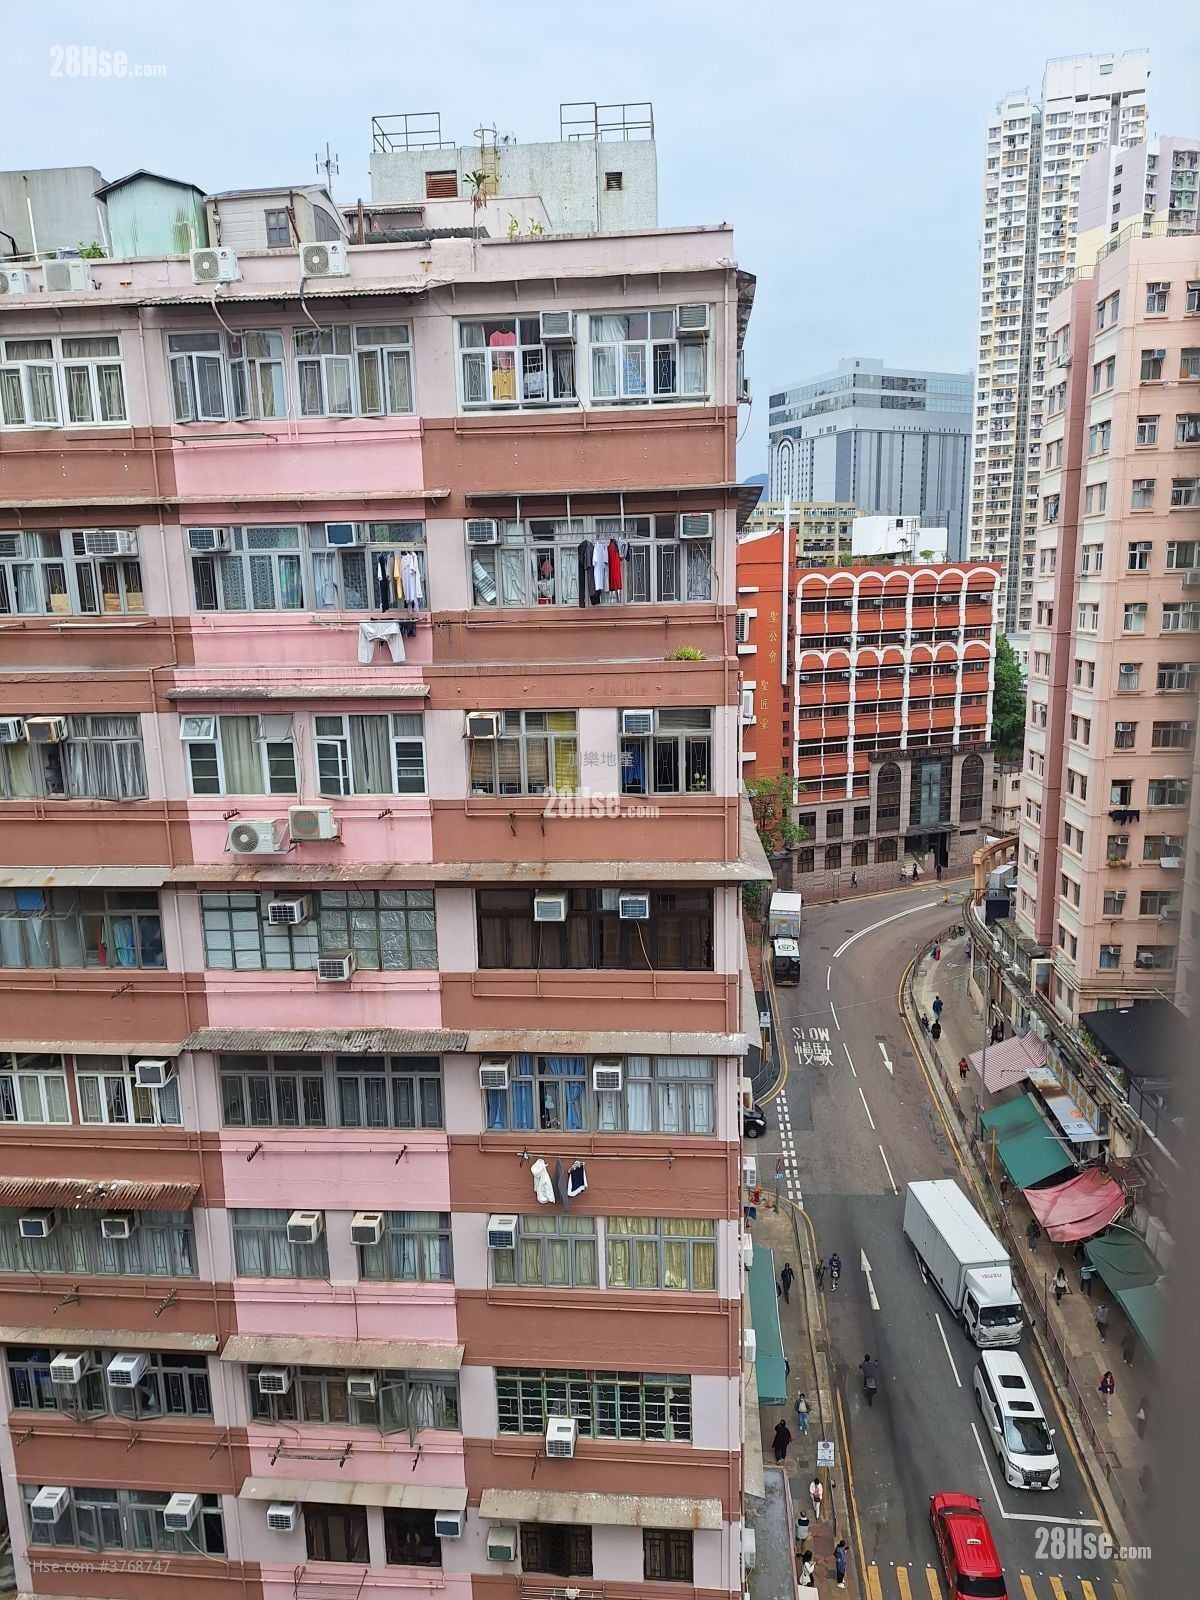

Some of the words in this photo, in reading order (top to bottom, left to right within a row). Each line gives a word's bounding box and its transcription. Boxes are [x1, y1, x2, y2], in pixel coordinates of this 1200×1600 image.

[768, 610, 778, 663] 聖公會
[793, 1041, 834, 1066] 慢駛
